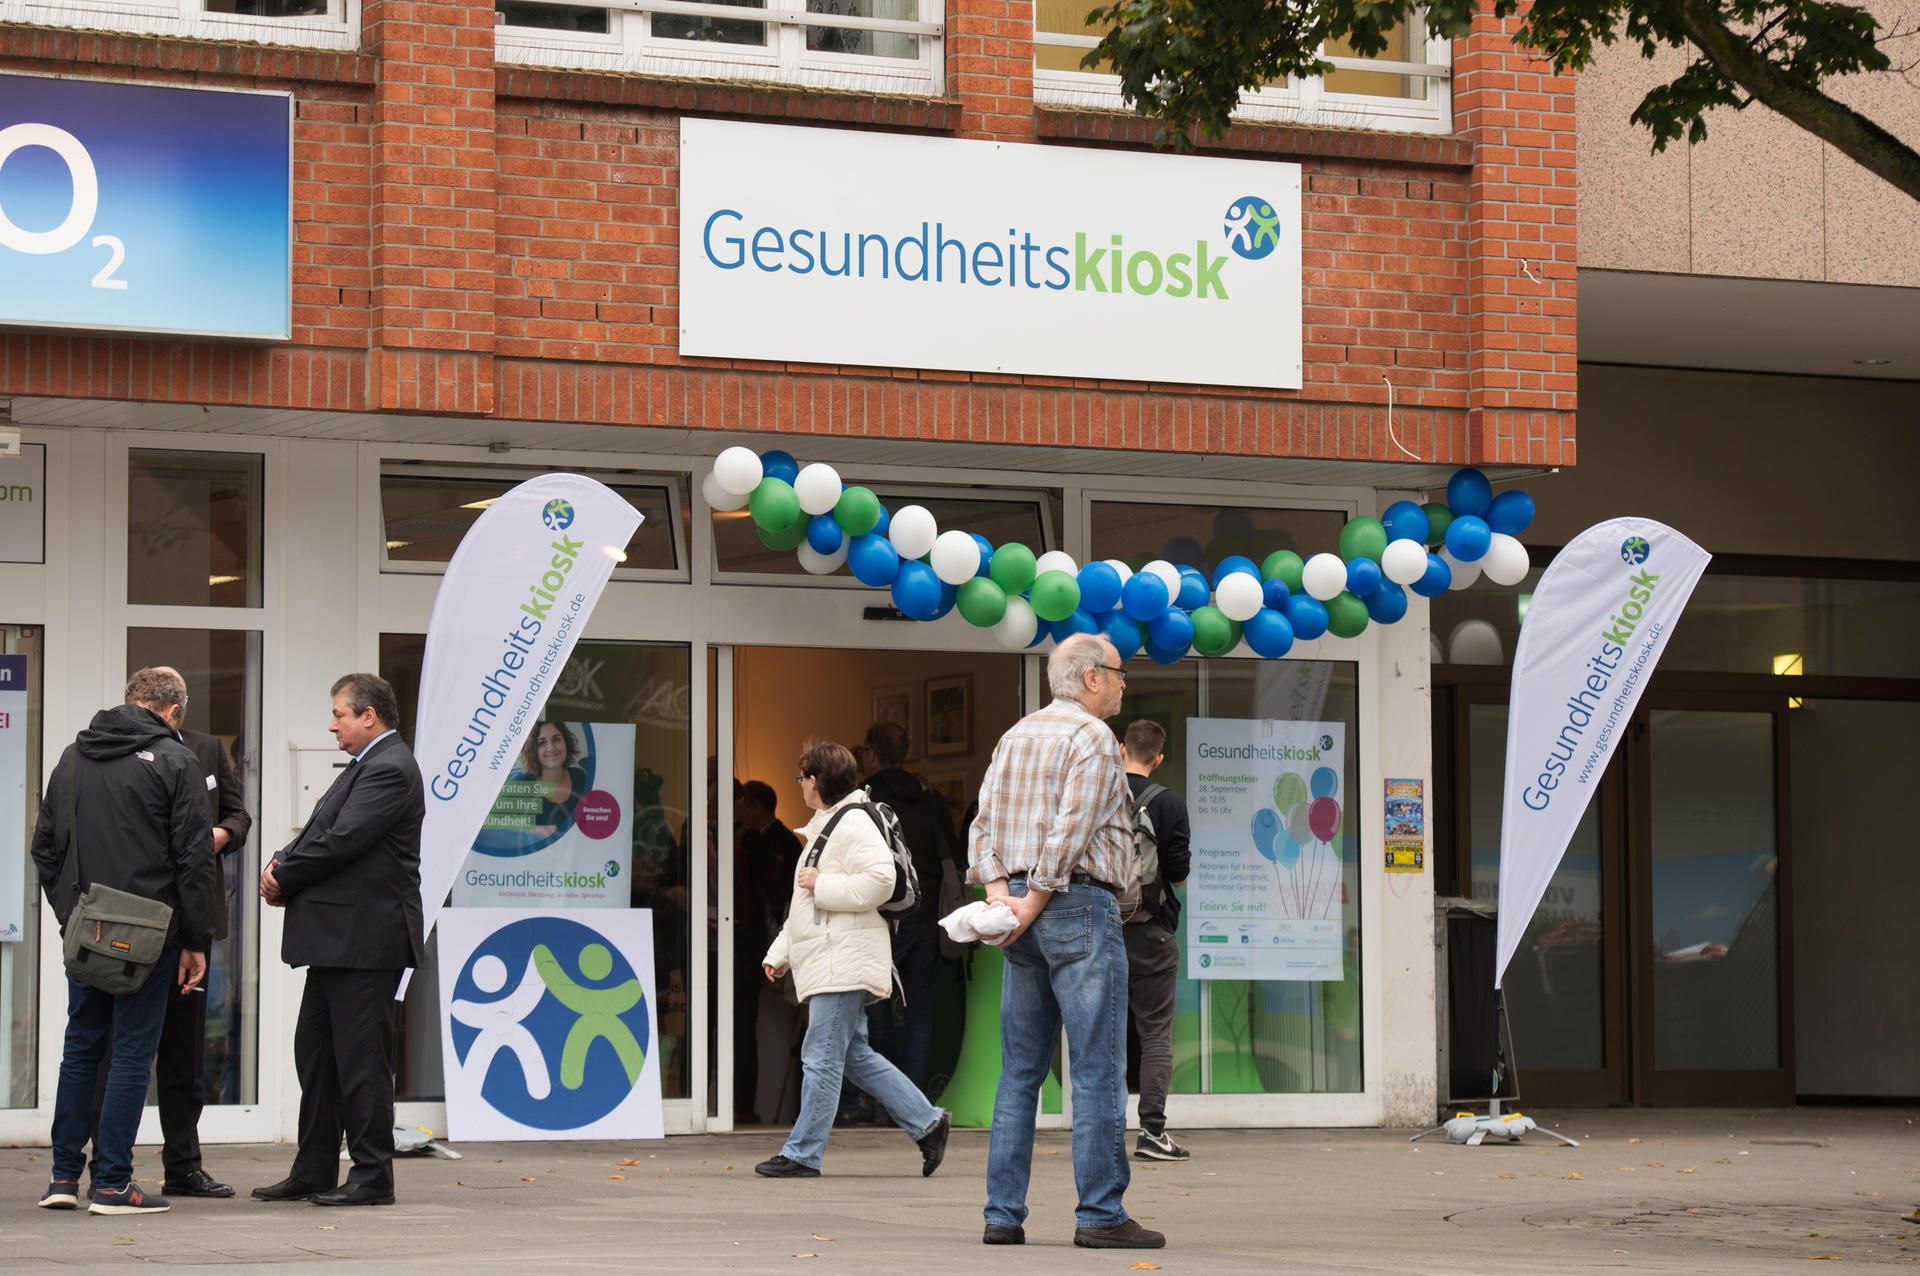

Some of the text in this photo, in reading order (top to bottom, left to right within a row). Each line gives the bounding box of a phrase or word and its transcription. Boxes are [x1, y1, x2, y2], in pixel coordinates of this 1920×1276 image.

[702, 208, 1230, 301] Gesundheitskiosk
[431, 534, 584, 801] Gesundheitskiosk
[488, 592, 586, 771] www.gesundheitskiosk.de
[1523, 567, 1661, 811] Gesundheitskiosk
[1577, 622, 1664, 784] www.gesundheitskiosk.de
[1198, 743, 1321, 761] Gesundheitskiosk
[1199, 773, 1258, 784] Eröffnungsfeier
[1210, 785, 1247, 794] September
[1199, 848, 1240, 858] Programm
[1199, 862, 1228, 871] Aktionen
[465, 869, 606, 889] Gesundheitskiosk
[1200, 901, 1227, 911] Feiern
[1231, 901, 1244, 912] Sie
